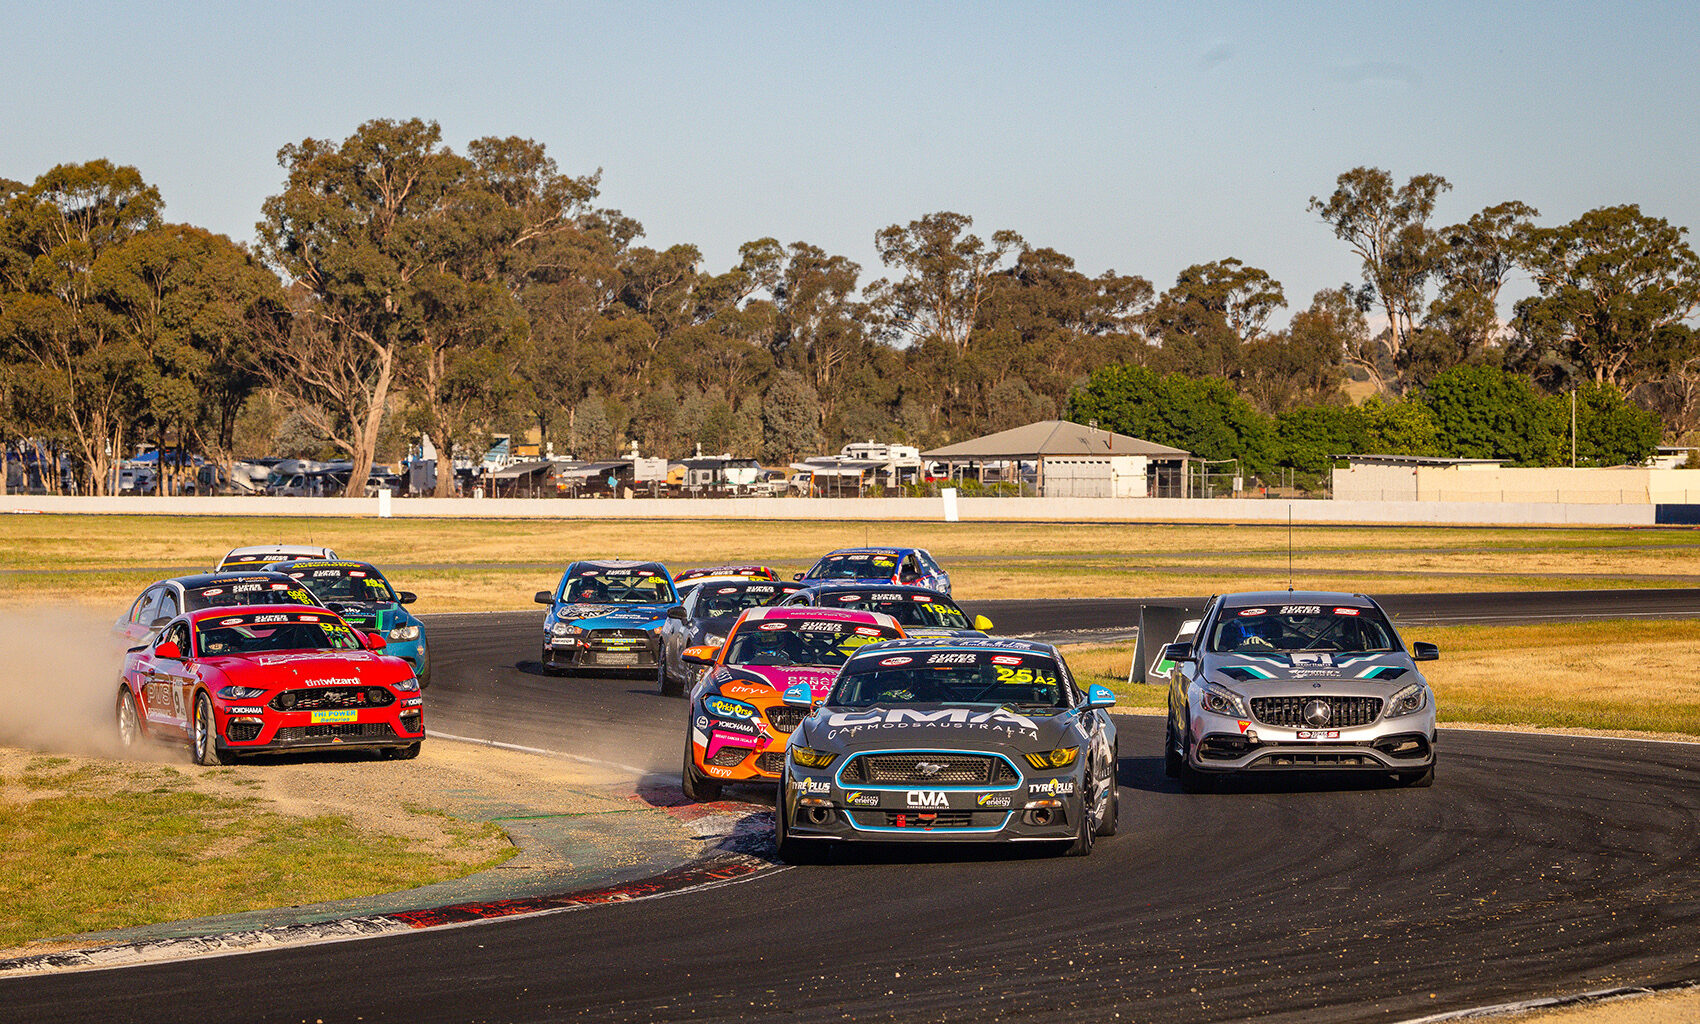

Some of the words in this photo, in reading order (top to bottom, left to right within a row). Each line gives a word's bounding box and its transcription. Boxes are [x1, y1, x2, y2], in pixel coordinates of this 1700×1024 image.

[320, 623, 333, 632] 9
[997, 668, 1033, 684] 25
[1034, 677, 1056, 686] A2
[828, 708, 1038, 731] CMA
[718, 721, 753, 732] YOKOHAMA
[1029, 784, 1054, 793] TYRE
[1057, 783, 1074, 792] PLUS
[855, 798, 879, 806] energy
[907, 791, 950, 806] CMA
